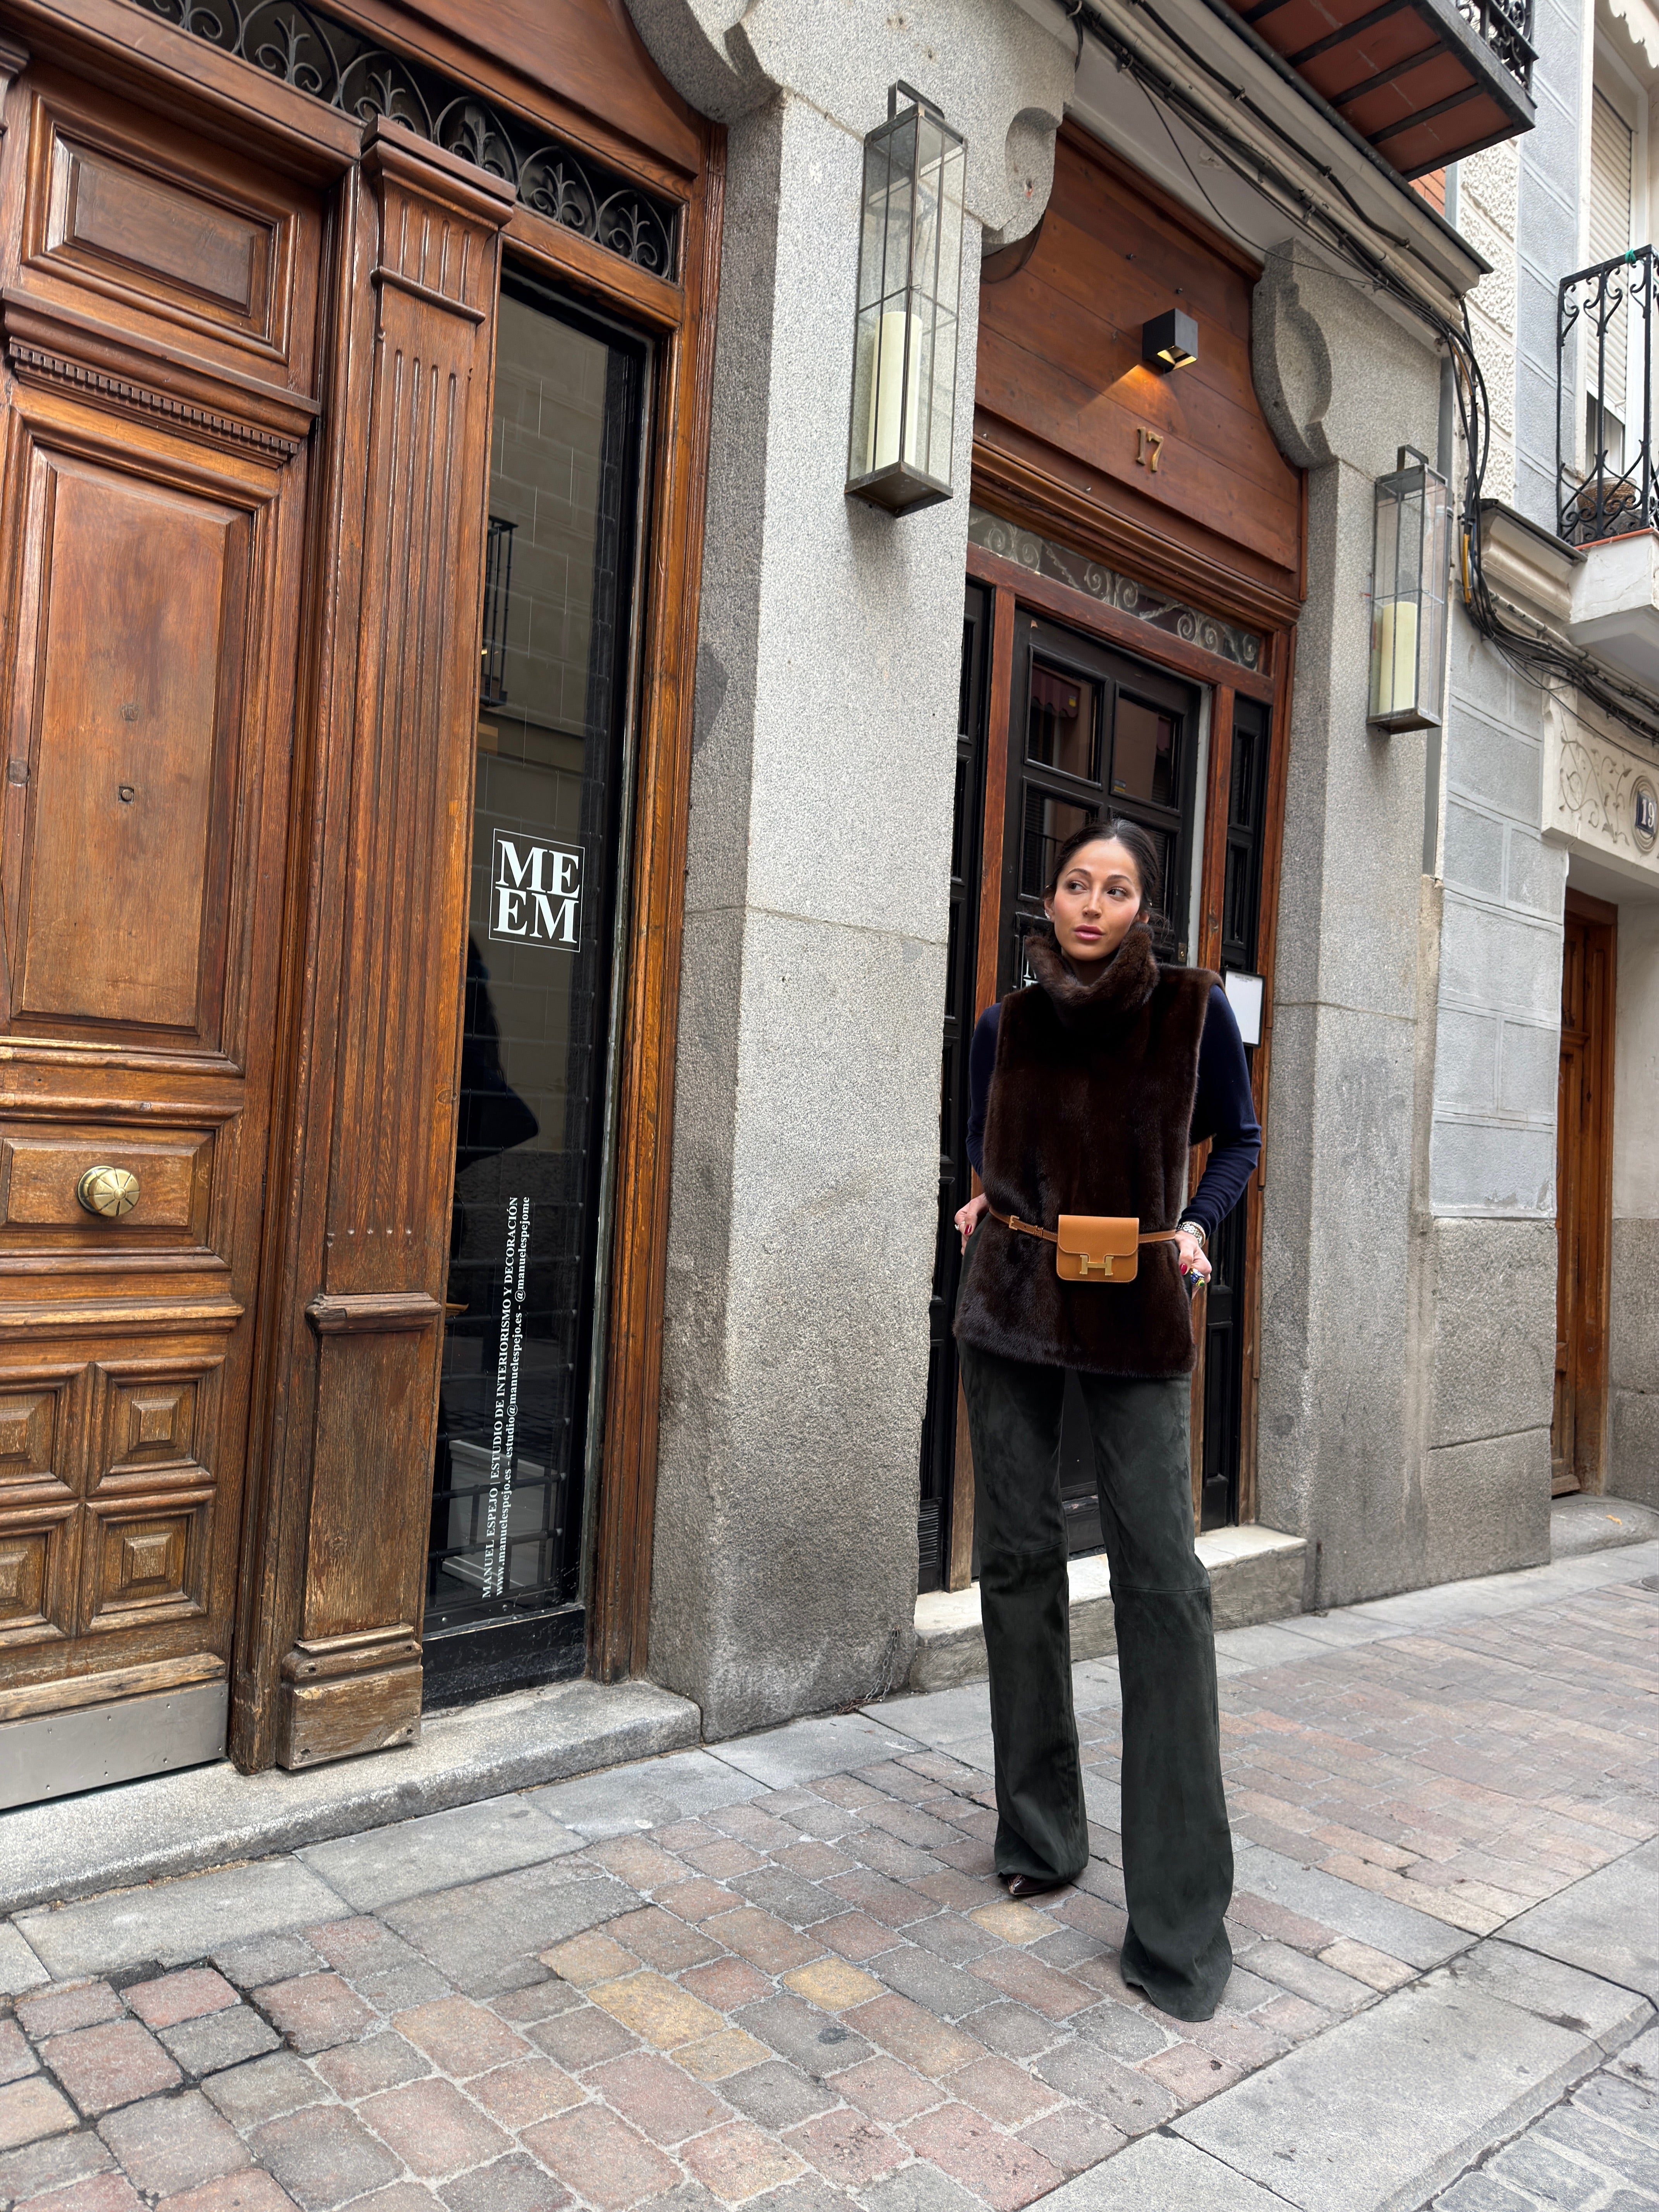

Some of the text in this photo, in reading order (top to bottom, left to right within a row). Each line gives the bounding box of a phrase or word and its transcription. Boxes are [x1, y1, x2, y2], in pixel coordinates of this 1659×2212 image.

[1137, 426, 1164, 472] 17
[1641, 799, 1654, 828] 19
[495, 839, 580, 898] ME
[493, 886, 579, 943] EM
[504, 1197, 518, 1284] DECORACIÓN
[503, 1286, 512, 1296] Y
[496, 1299, 511, 1397] INTERIORISMO
[495, 1400, 504, 1418] DE
[496, 1469, 512, 1596] www.manuelespejo.es
[505, 1313, 522, 1457] estudio@manuelespejo.es
[515, 1197, 530, 1302] @manuelespejome
[491, 1421, 502, 1479] ESTUDIO
[487, 1488, 498, 1537] ESPEJO
[482, 1540, 494, 1599] MANUEL
